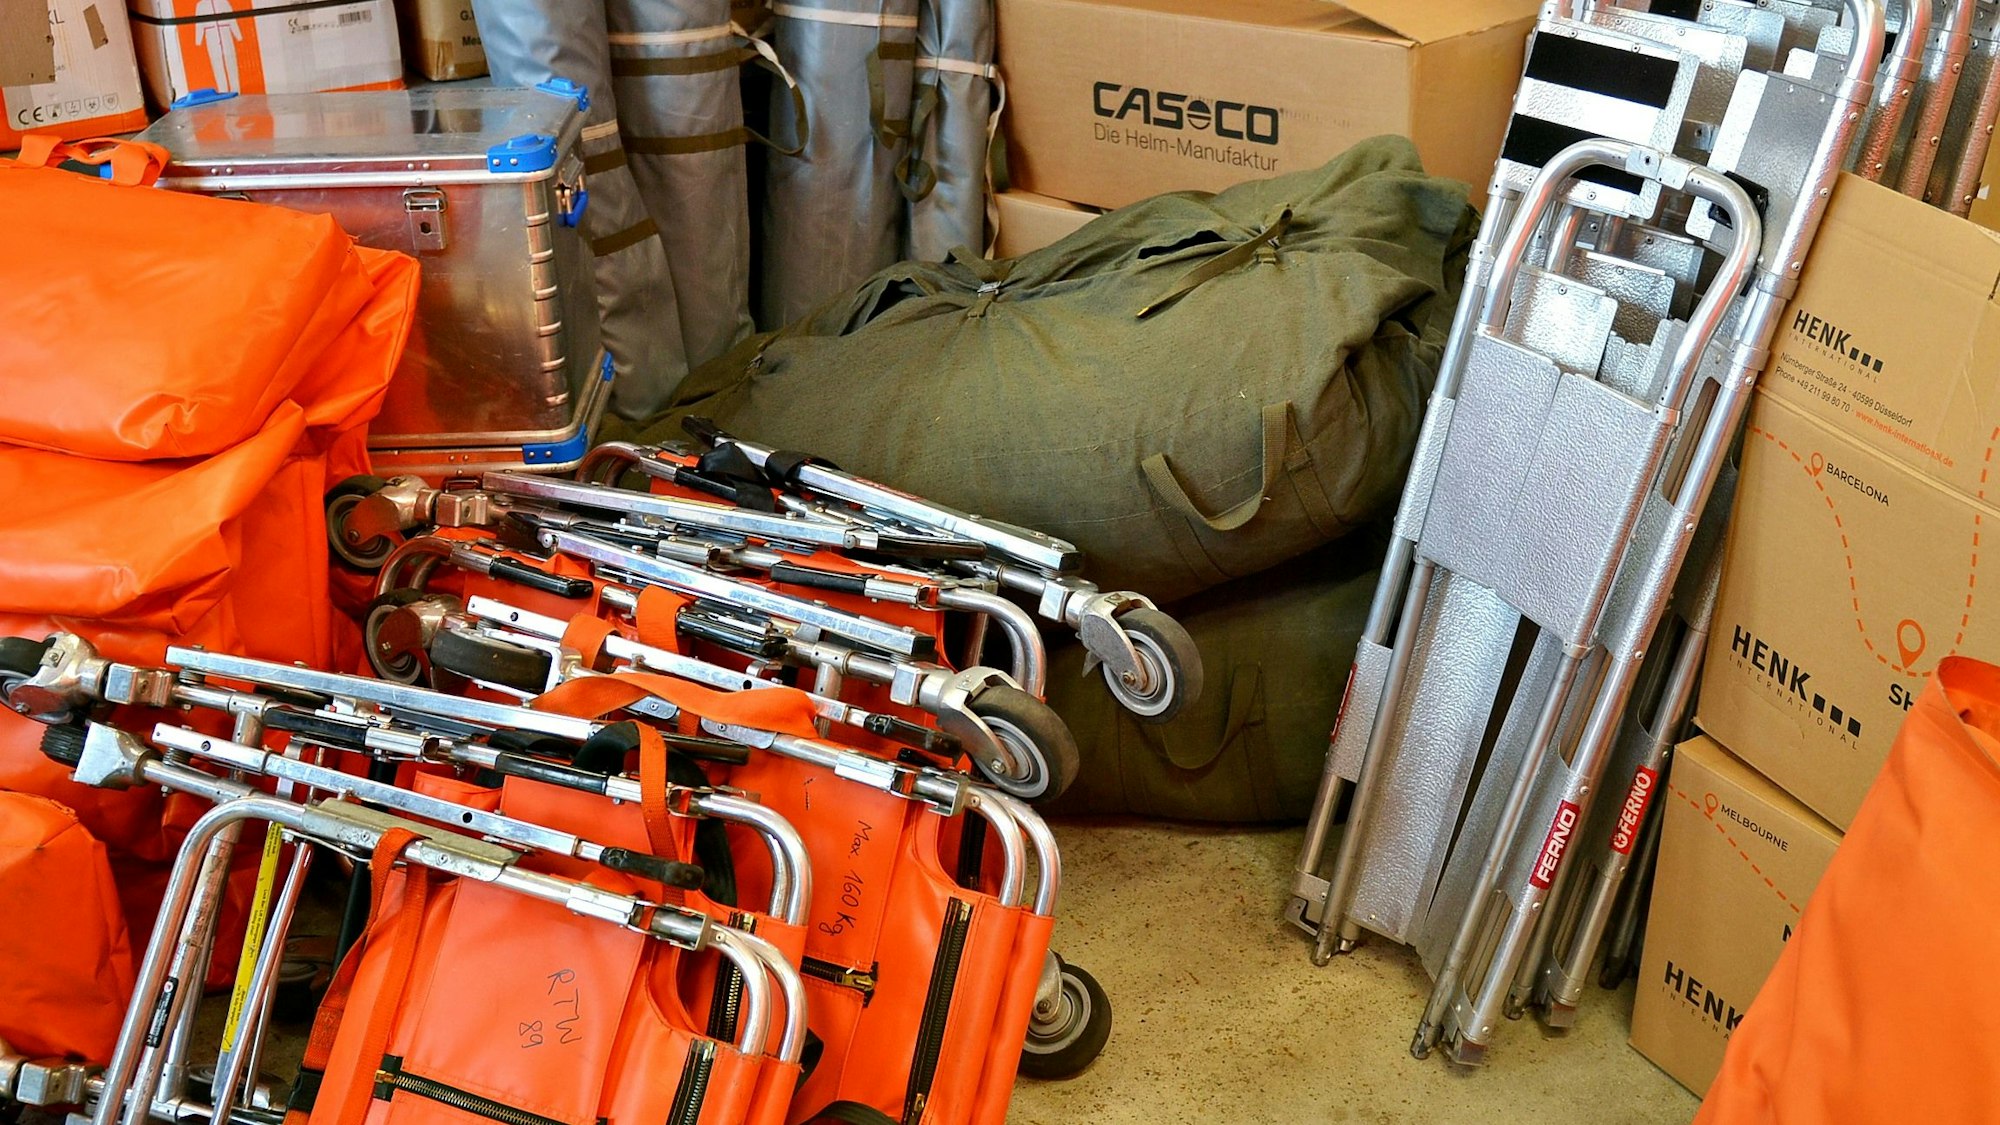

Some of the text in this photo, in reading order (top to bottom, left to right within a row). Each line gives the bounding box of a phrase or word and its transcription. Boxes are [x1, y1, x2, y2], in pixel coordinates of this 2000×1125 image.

[1094, 122, 1279, 172] Die Helm-Manufaktur
[1788, 332, 1879, 383] INTERNATIONAL
[1775, 366, 1796, 383] Phone
[1797, 379, 1809, 390] +49
[1808, 384, 1821, 396] 211
[1821, 390, 1831, 402] 99
[1830, 396, 1840, 407] 80
[1840, 401, 1851, 412] 70
[1780, 352, 1816, 376] Nürnberger
[1815, 370, 1837, 388] Straße
[1837, 382, 1848, 393] 24
[1851, 390, 1874, 408] 40599
[1874, 401, 1913, 428] Düsseldorf
[1826, 462, 1889, 507] BARCELONA
[1729, 654, 1857, 750] INTERNATIONAL
[1617, 771, 1652, 836] FERNO
[1720, 804, 1789, 852] MELBOURNE
[1537, 808, 1577, 883] FERNO
[841, 869, 864, 908] 160
[1664, 960, 1744, 1031] HENK
